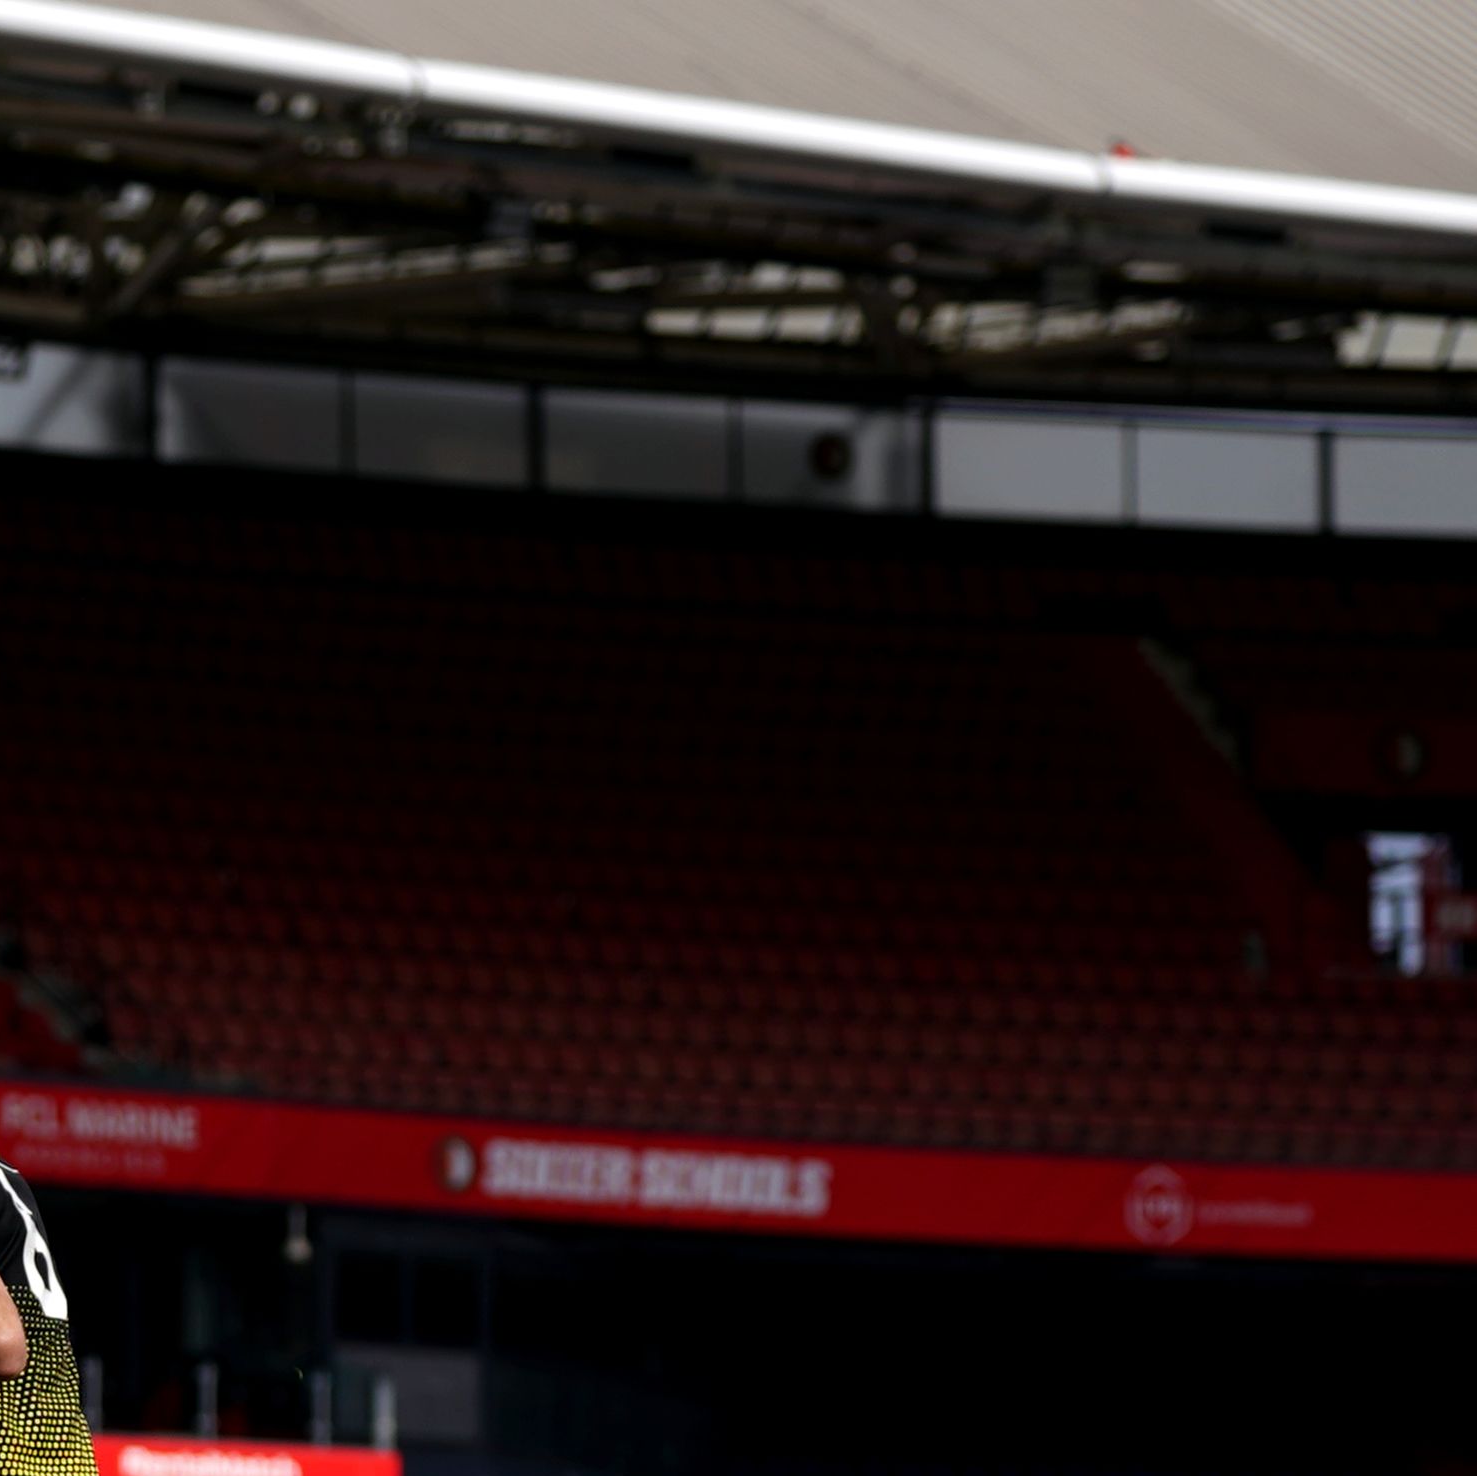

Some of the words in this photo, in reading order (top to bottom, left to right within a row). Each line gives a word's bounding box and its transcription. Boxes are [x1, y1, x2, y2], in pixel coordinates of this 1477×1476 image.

[65, 1098, 199, 1150] MARINE
[482, 1136, 635, 1207] SOCCER
[640, 1147, 834, 1218] SCHOOLS
